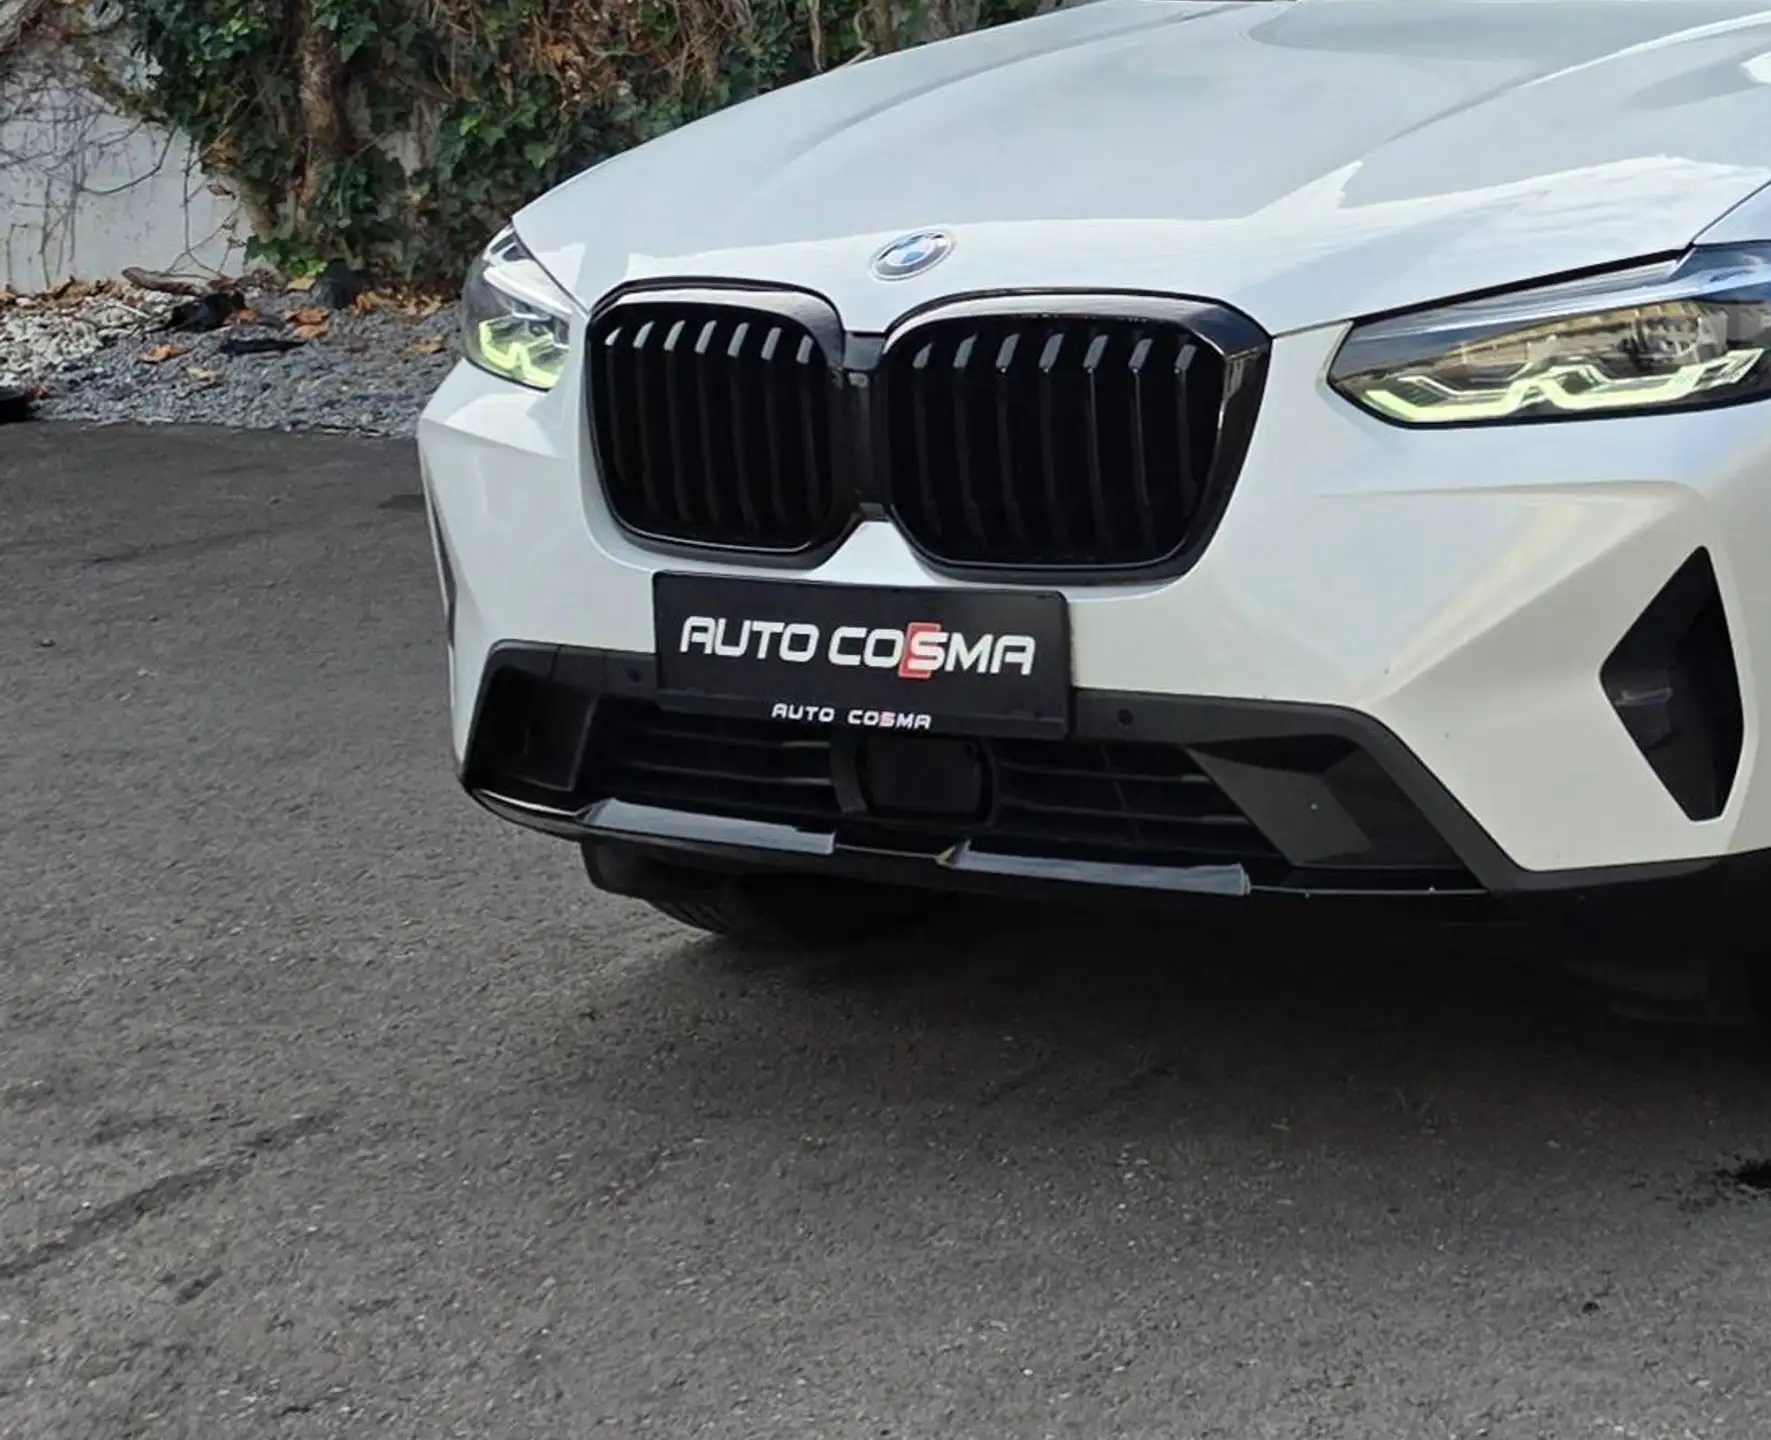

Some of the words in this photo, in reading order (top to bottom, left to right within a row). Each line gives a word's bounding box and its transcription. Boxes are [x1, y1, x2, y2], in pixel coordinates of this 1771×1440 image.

[679, 615, 819, 663] AUTO
[827, 625, 1036, 676] COSMA
[771, 702, 836, 724] AUTO
[847, 709, 932, 730] COSMA
